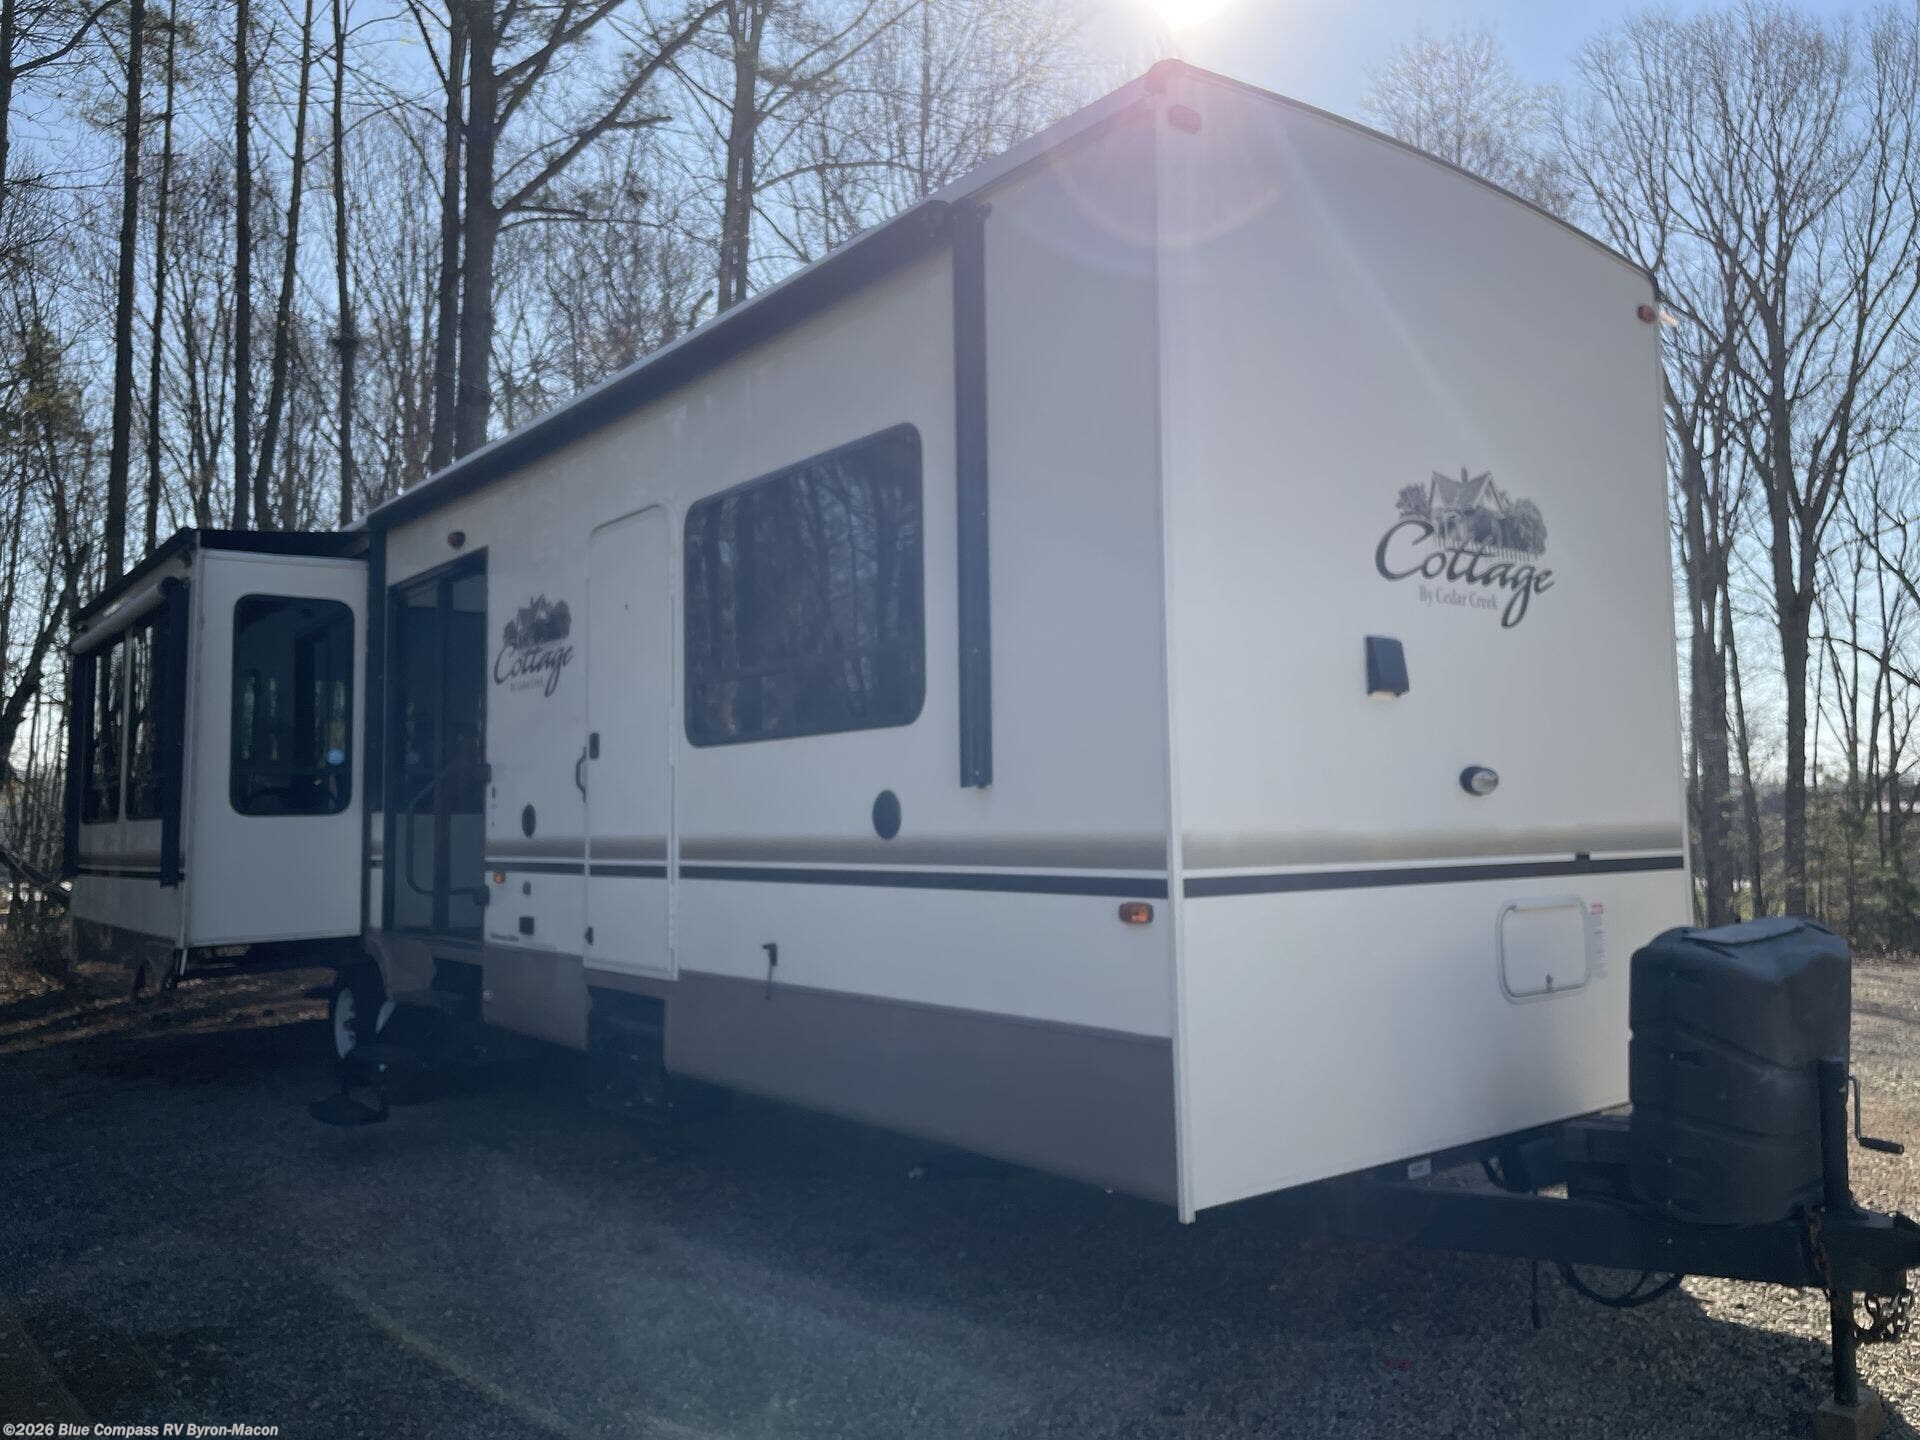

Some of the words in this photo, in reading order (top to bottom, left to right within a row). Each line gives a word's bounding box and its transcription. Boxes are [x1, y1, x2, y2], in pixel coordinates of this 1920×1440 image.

[1375, 519, 1555, 629] Cottage
[1435, 587, 1466, 606] Cedar
[1469, 591, 1498, 610] Creek
[494, 645, 574, 698] Cottage
